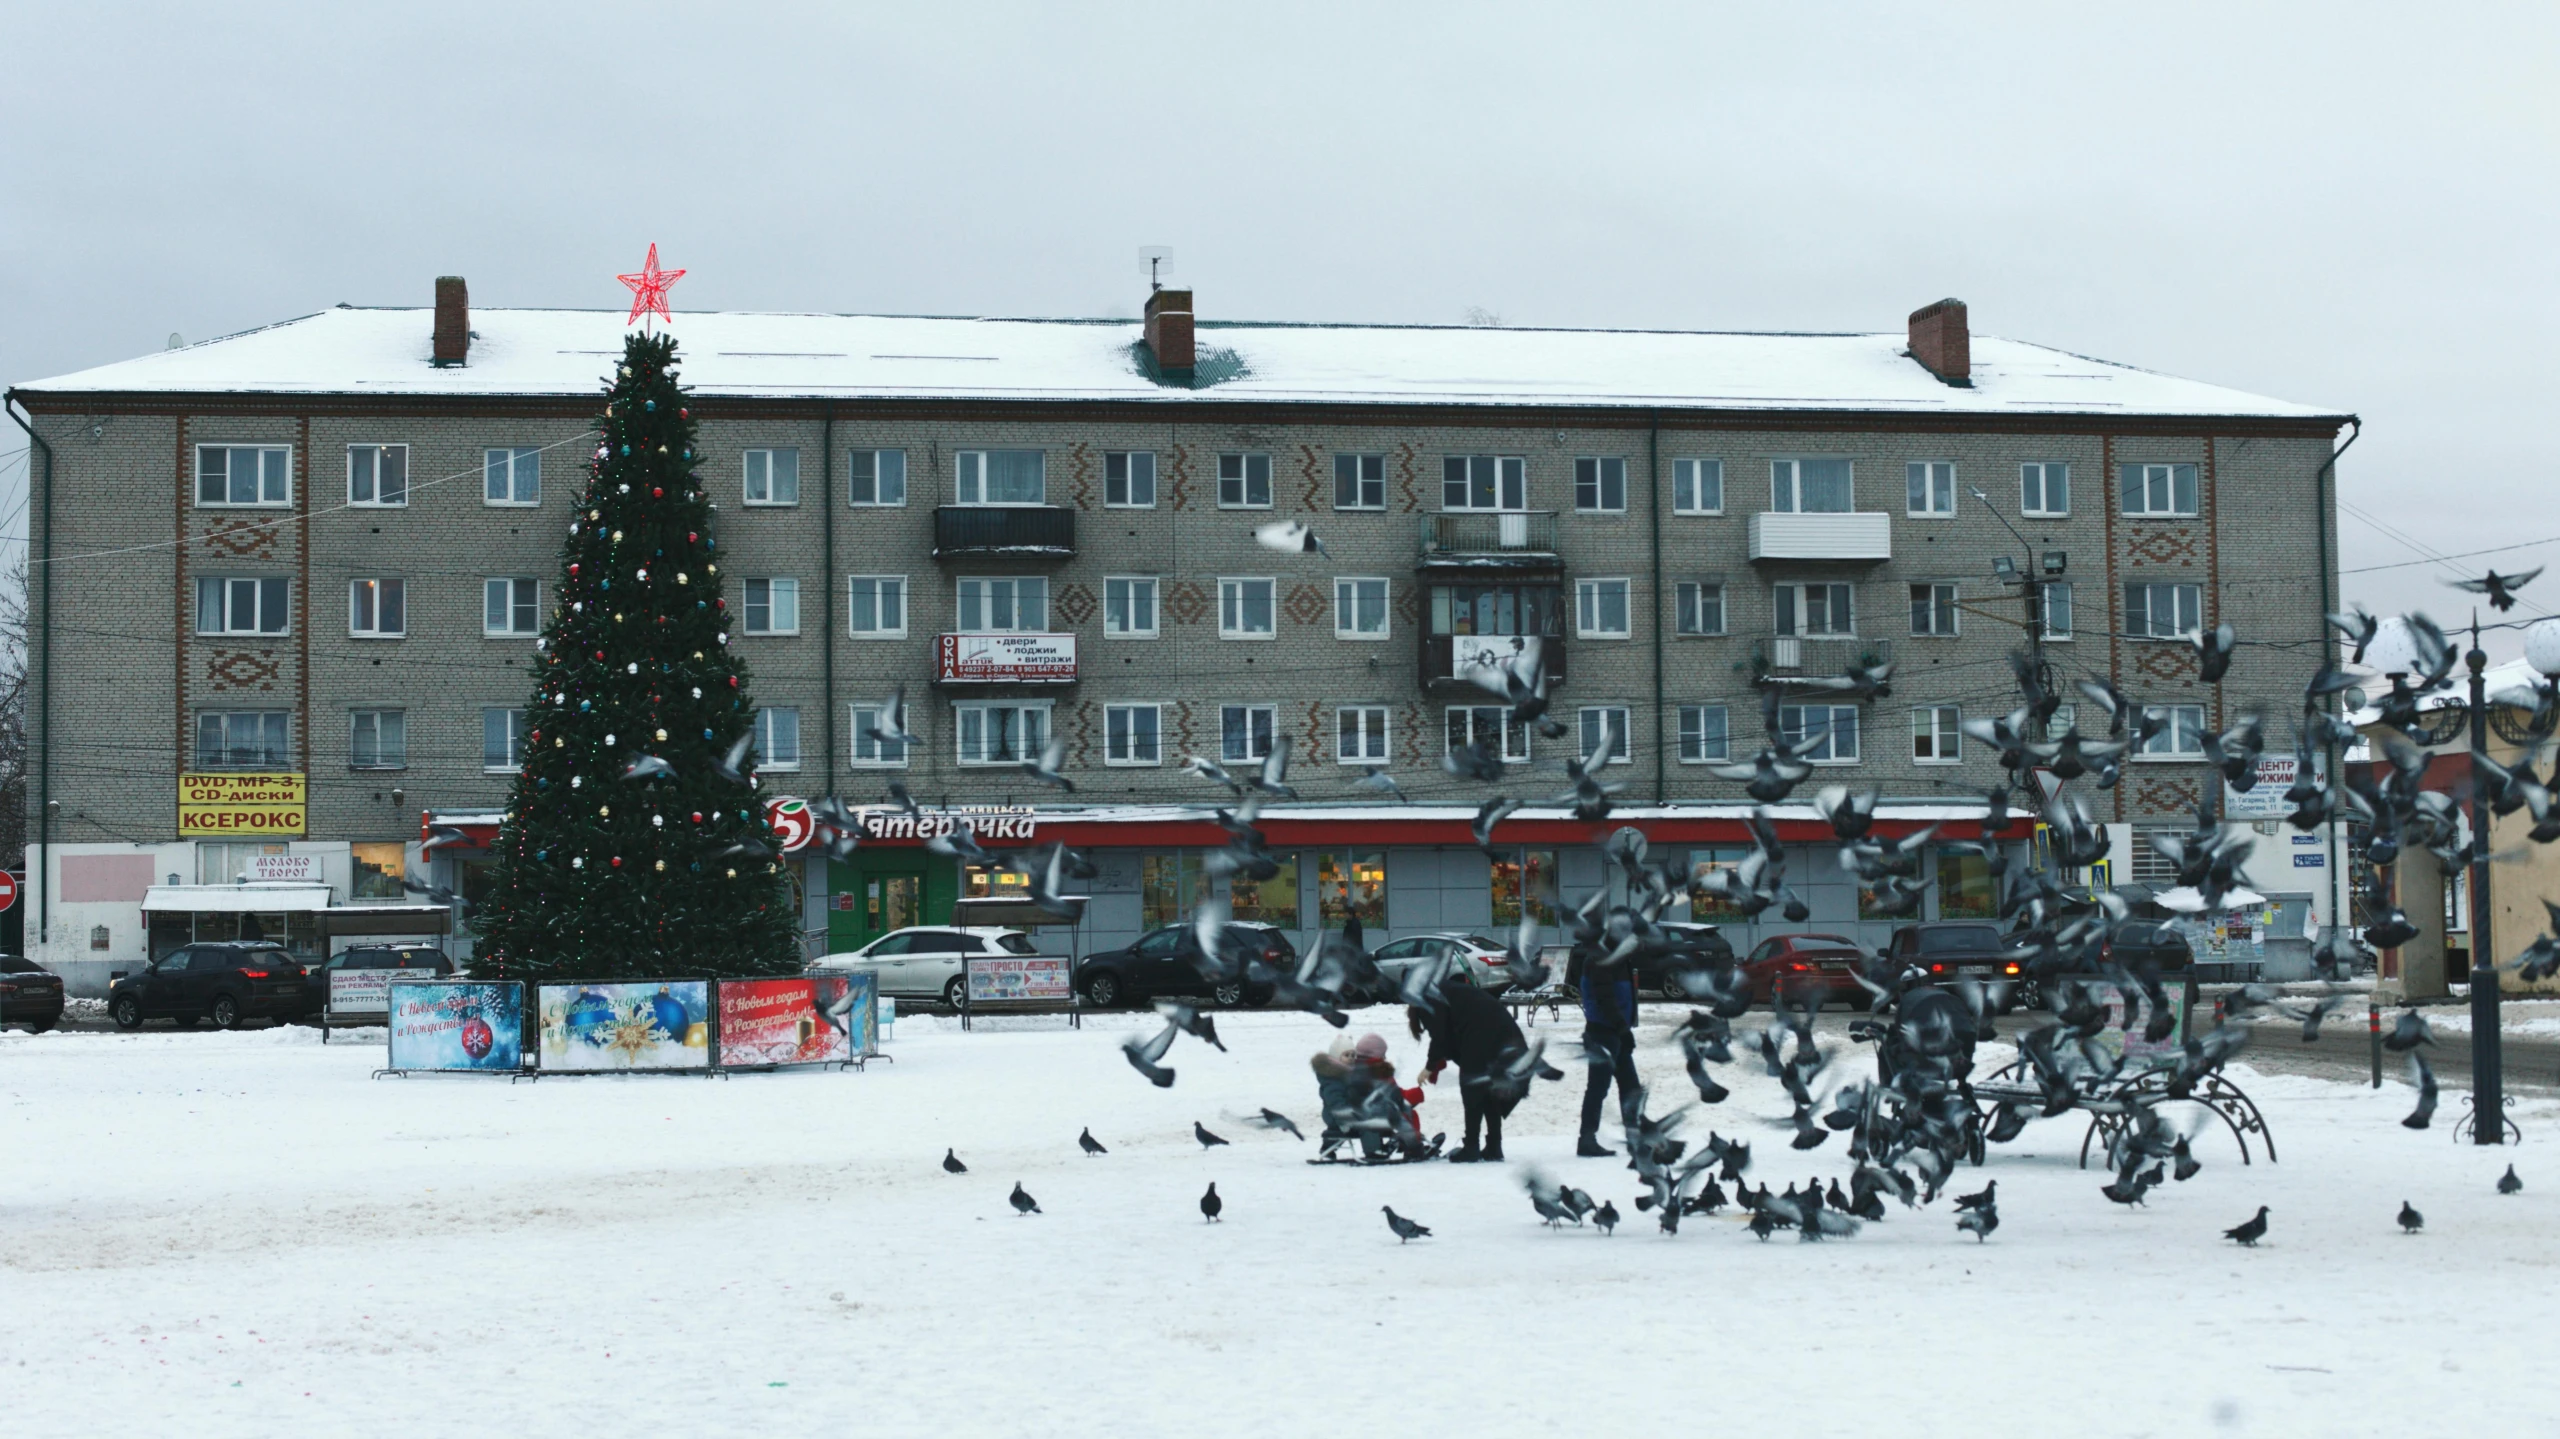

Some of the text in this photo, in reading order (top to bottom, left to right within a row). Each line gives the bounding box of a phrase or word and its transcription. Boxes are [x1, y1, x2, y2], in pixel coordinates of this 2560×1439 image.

[1002, 637, 1037, 646] двери
[1013, 647, 1057, 655] лоджии
[943, 636, 955, 678] ОКНА
[1024, 656, 1072, 664] витражи
[1038, 664, 1075, 673] 647-97-26
[2256, 761, 2295, 774] ЦЕНТР
[184, 776, 301, 790] DVD, MP-3,
[190, 789, 295, 802] CD-диски
[961, 805, 1036, 815] УНИВЕРСАМ
[183, 812, 302, 828] КСЕРОКС
[256, 857, 310, 867] МОЛОКО
[258, 868, 309, 878] ТВОРОГ
[990, 961, 1023, 972] ПРОСТО
[332, 975, 387, 983] СДАЮ МЕСТО
[726, 989, 808, 1014] С Новым годом
[398, 1002, 406, 1017] С
[397, 1028, 405, 1037] и
[725, 1023, 733, 1035] и
